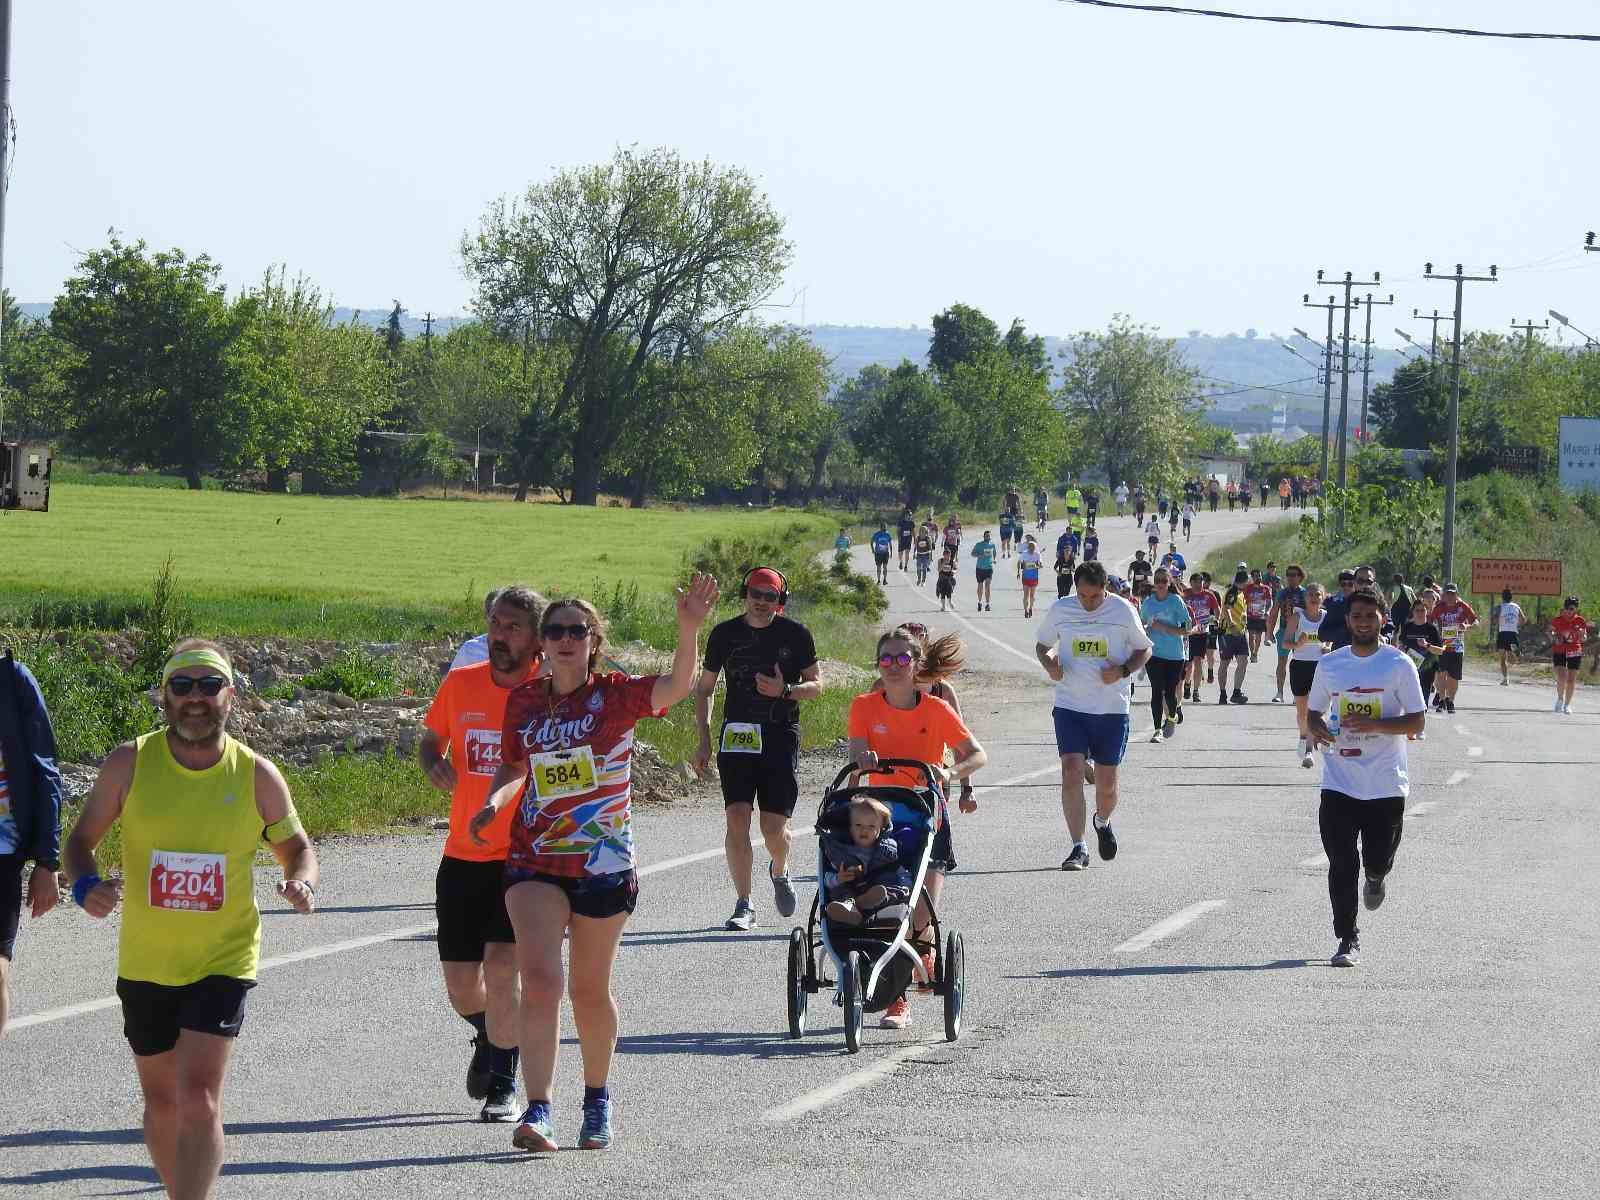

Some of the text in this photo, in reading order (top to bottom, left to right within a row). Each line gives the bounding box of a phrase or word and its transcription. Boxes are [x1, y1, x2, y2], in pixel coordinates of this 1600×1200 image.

[1079, 641, 1099, 652] 971
[517, 714, 595, 751] Edirne
[545, 763, 580, 785] 584
[157, 871, 216, 897] 1204
